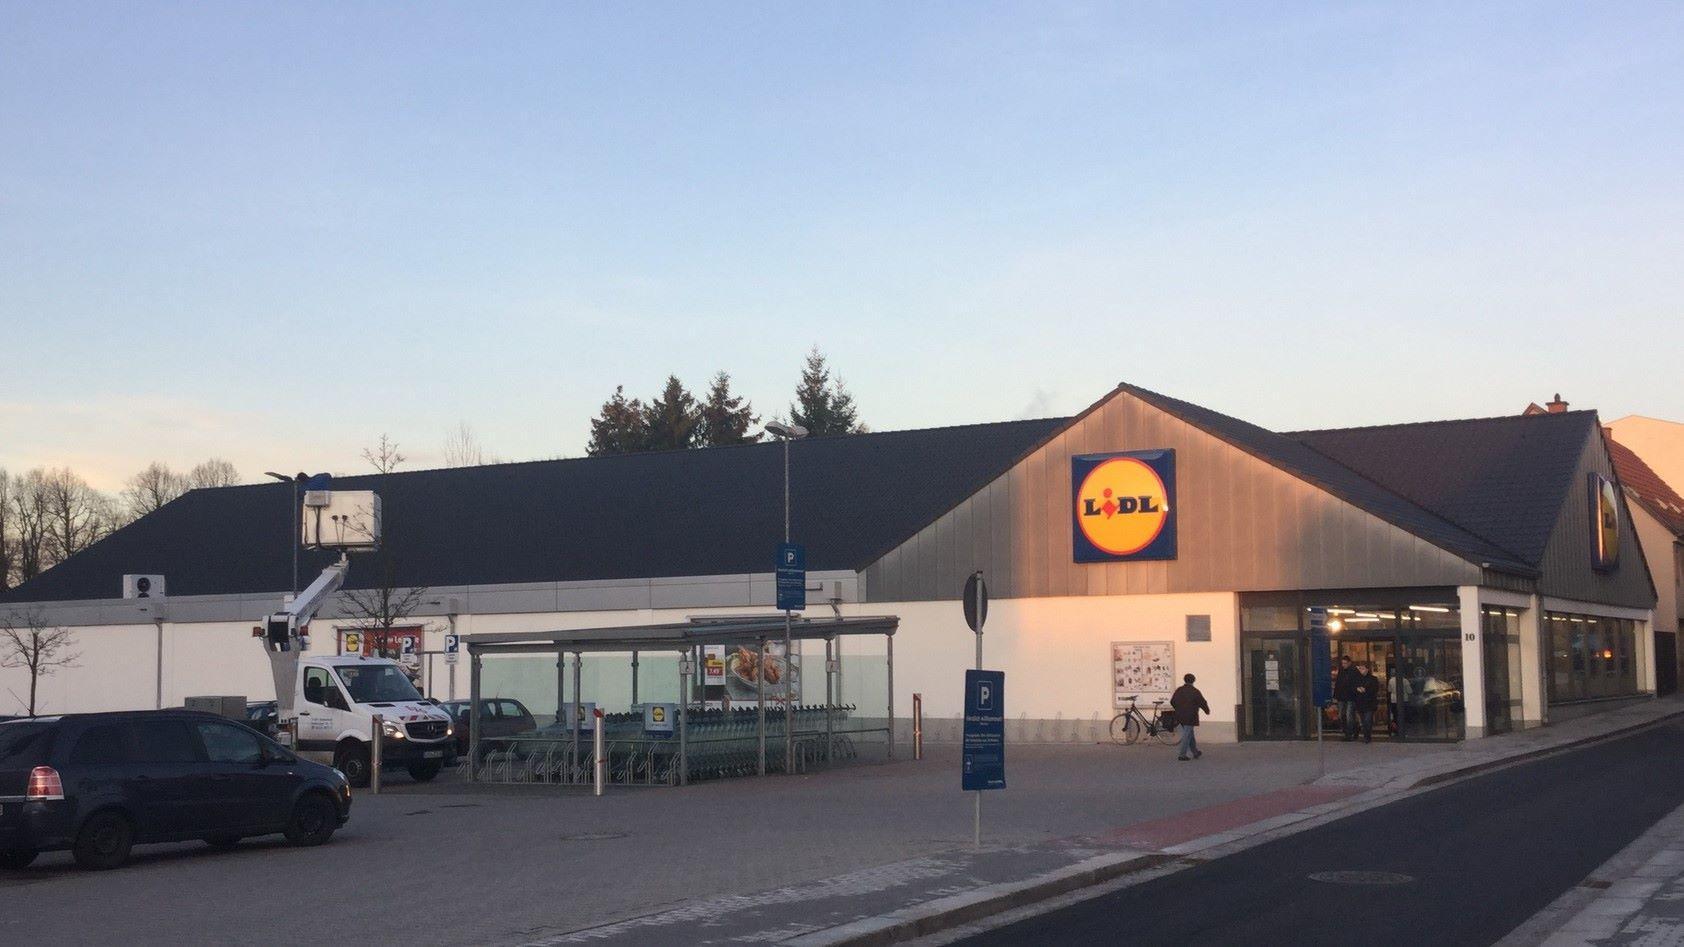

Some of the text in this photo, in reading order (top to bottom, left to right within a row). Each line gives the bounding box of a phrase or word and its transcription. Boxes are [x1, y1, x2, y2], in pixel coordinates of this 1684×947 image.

[787, 552, 795, 563] P
[1465, 633, 1475, 641] 10
[446, 636, 456, 653] P
[981, 686, 990, 705] P
